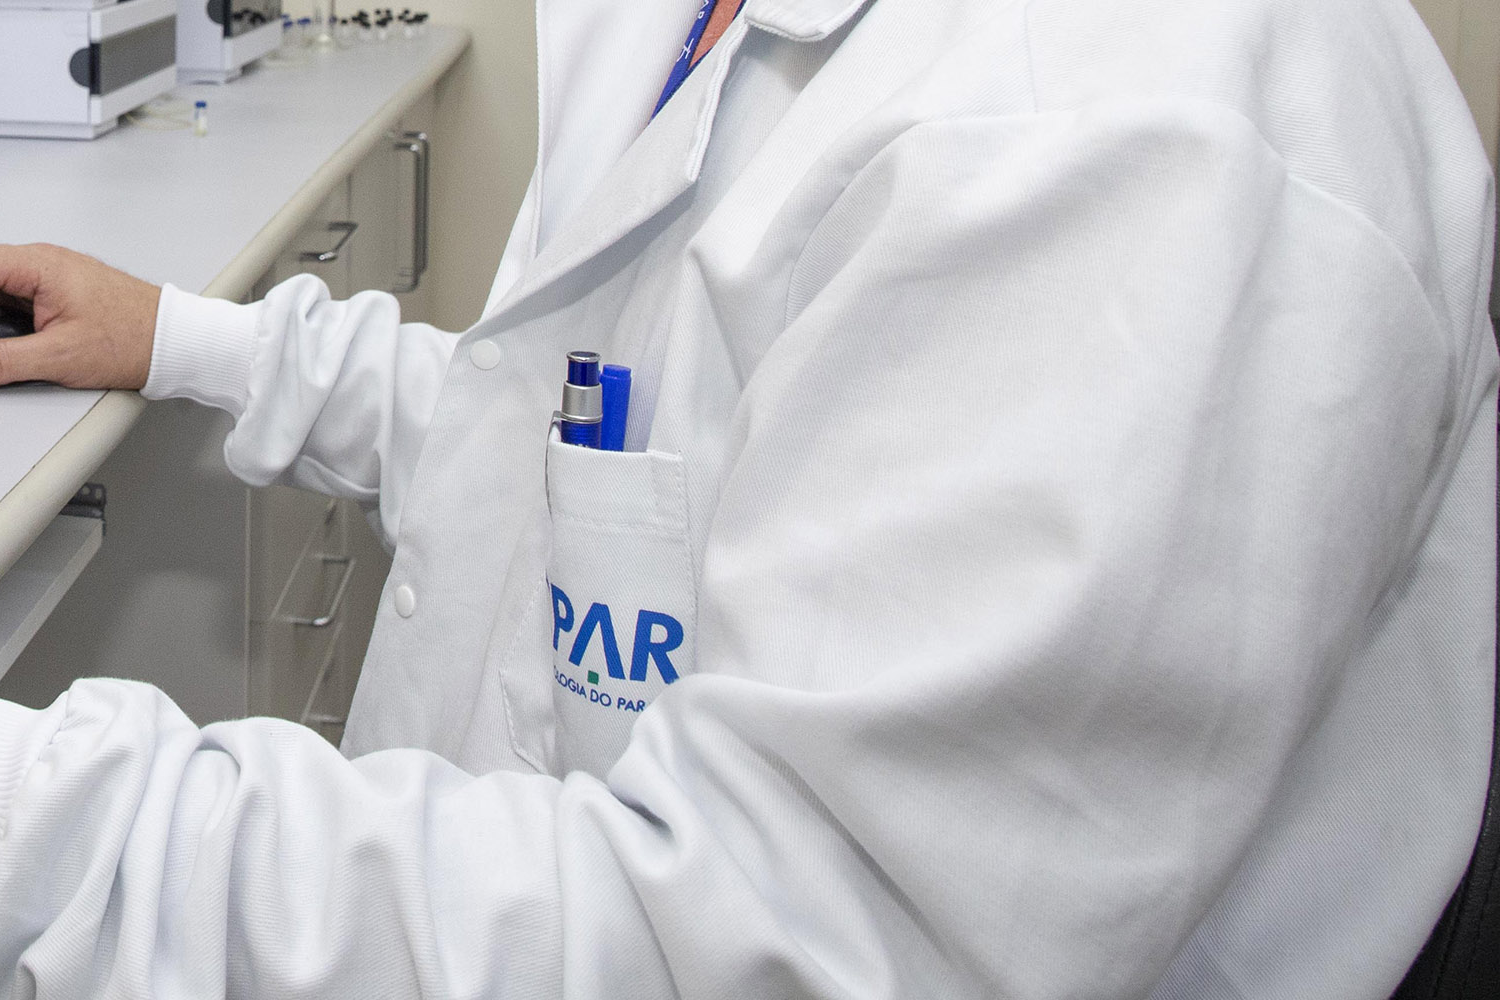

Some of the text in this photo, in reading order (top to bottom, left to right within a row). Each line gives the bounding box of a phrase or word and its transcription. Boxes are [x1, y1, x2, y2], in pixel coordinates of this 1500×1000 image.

[550, 583, 684, 685] PAR
[554, 665, 646, 713] LOGIA DO PAR
